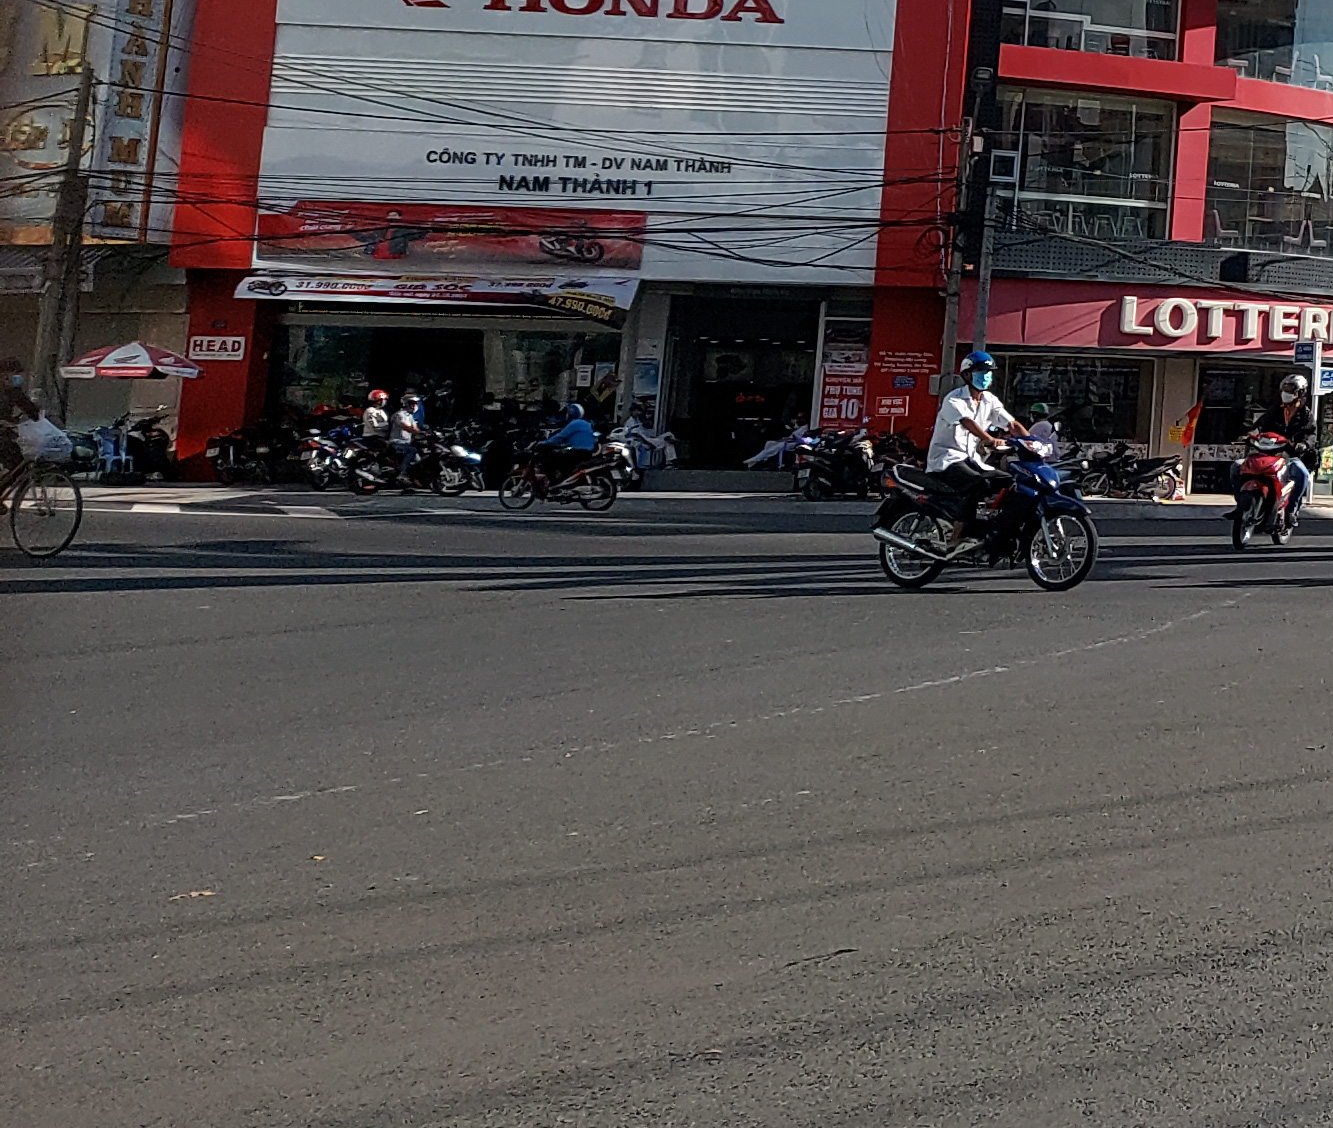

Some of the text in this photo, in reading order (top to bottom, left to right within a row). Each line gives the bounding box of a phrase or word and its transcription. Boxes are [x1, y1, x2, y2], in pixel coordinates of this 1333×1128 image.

[426, 147, 477, 165] CÔNG
[483, 152, 505, 166] TY
[511, 153, 557, 168] TNHH
[563, 155, 587, 169] TM
[601, 157, 625, 170] DV
[630, 158, 668, 172] NAM
[499, 174, 550, 193] NAM
[644, 180, 654, 196] 1
[192, 339, 242, 353] HEAD
